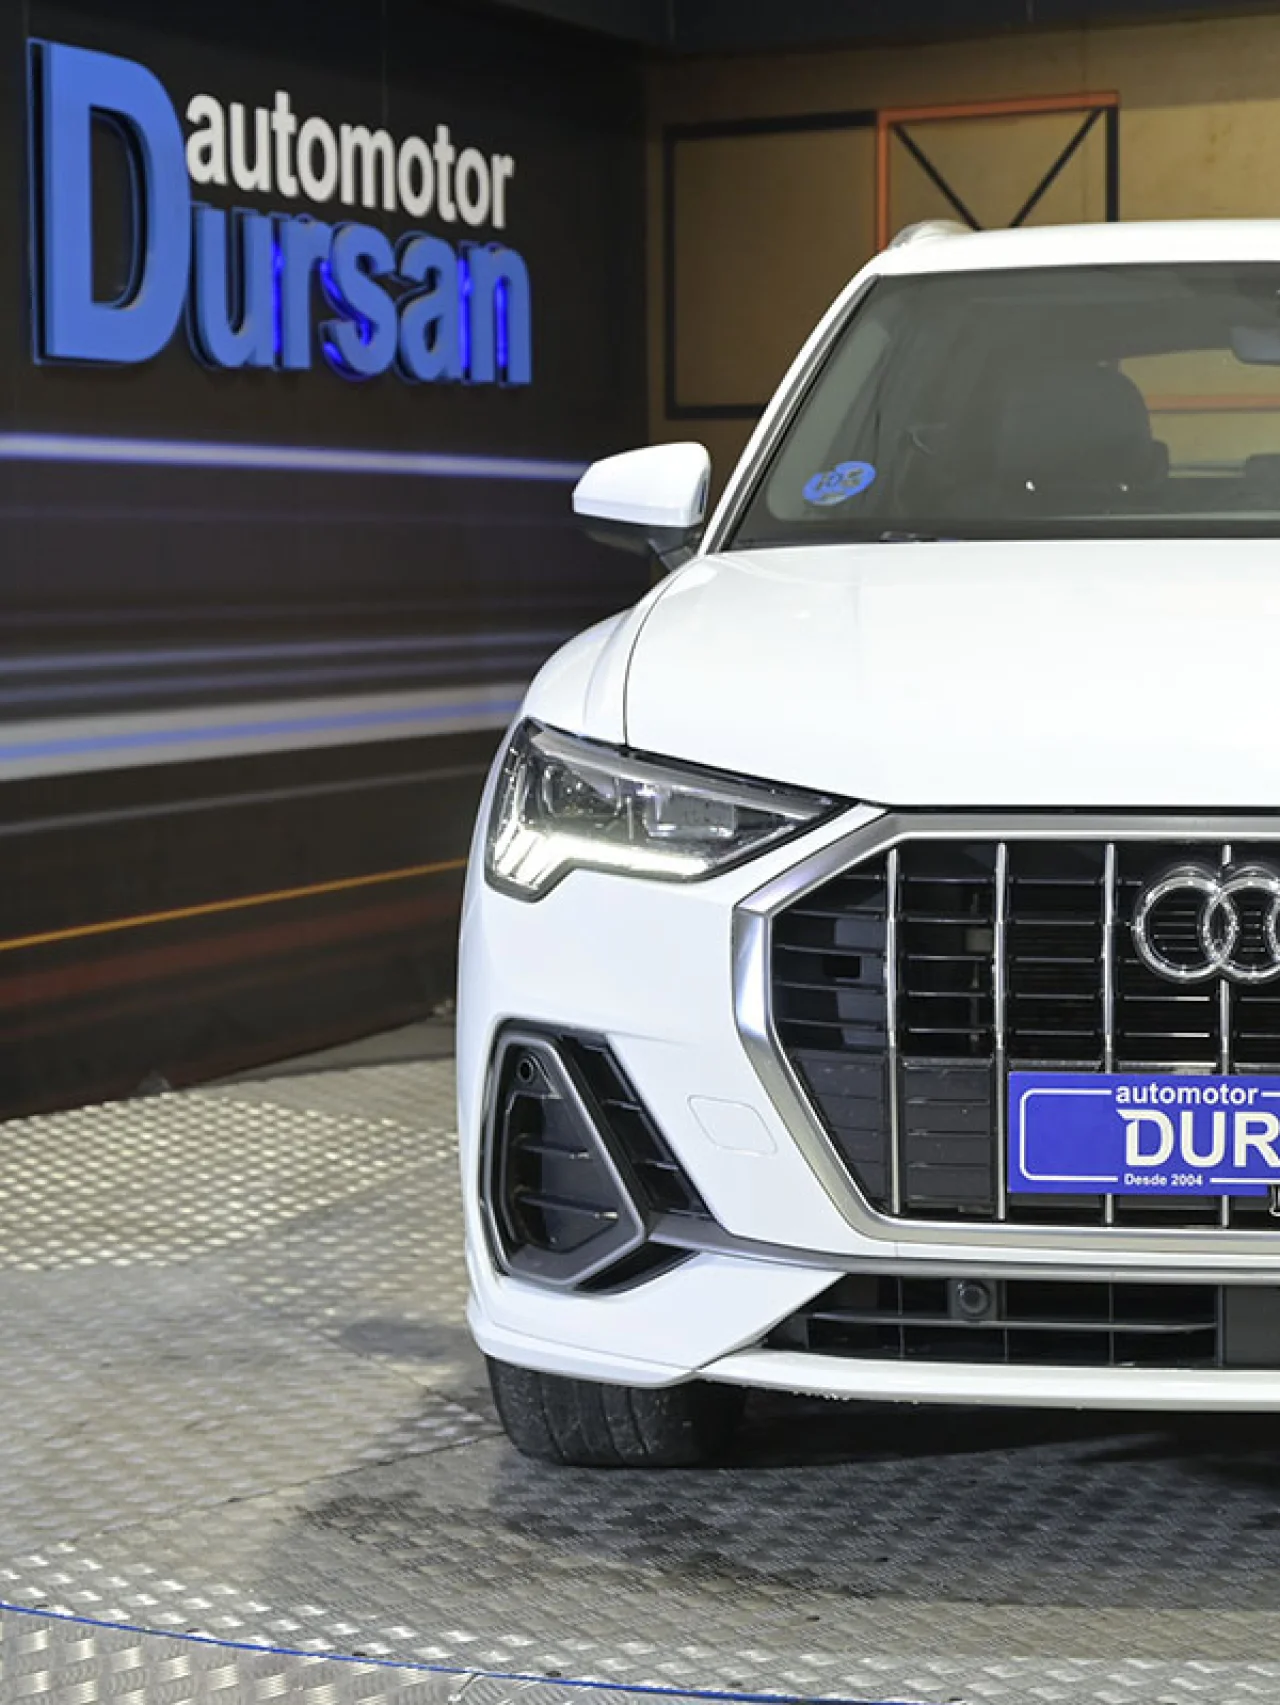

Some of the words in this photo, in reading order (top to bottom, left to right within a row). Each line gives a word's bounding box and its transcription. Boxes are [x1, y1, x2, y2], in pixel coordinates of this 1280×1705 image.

[185, 90, 514, 228] automotor
[28, 37, 532, 386] Dursan
[1116, 1083, 1259, 1105] automotor
[1124, 1173, 1167, 1187] Desde
[1171, 1173, 1203, 1187] 2004
